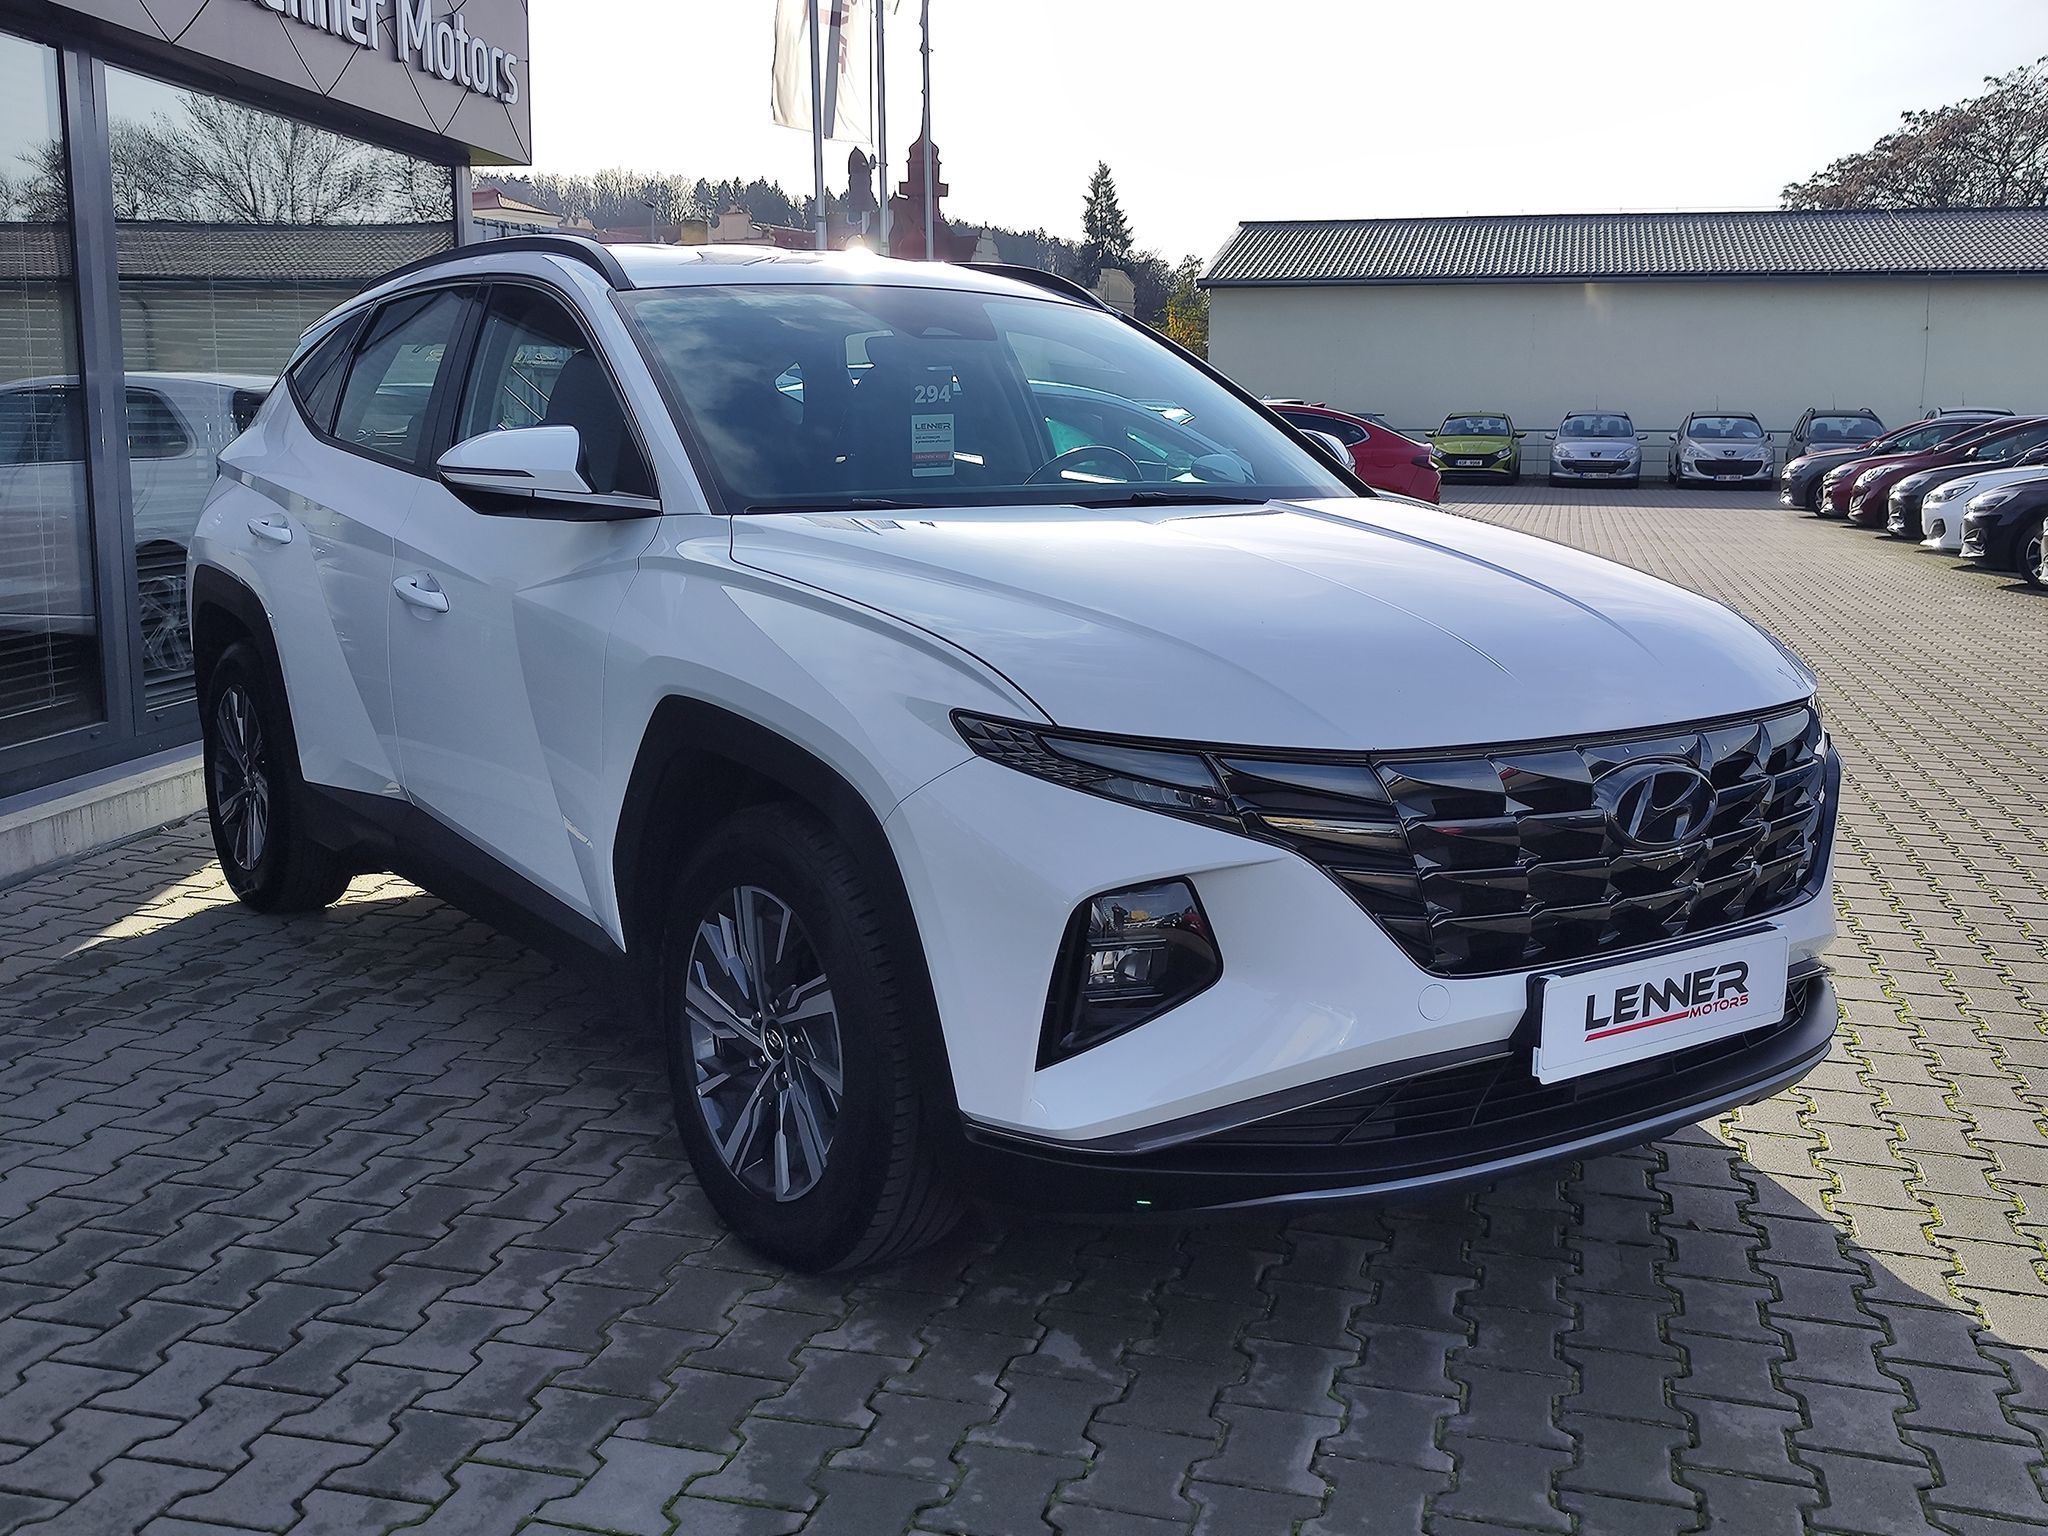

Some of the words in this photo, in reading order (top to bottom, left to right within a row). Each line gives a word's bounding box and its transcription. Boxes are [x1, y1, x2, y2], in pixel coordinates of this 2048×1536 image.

[397, 0, 519, 104] Motors
[914, 384, 951, 403] 294
[915, 422, 952, 431] LENNER
[1585, 960, 1749, 1031] LENNER
[1689, 993, 1749, 1018] MOTORS
